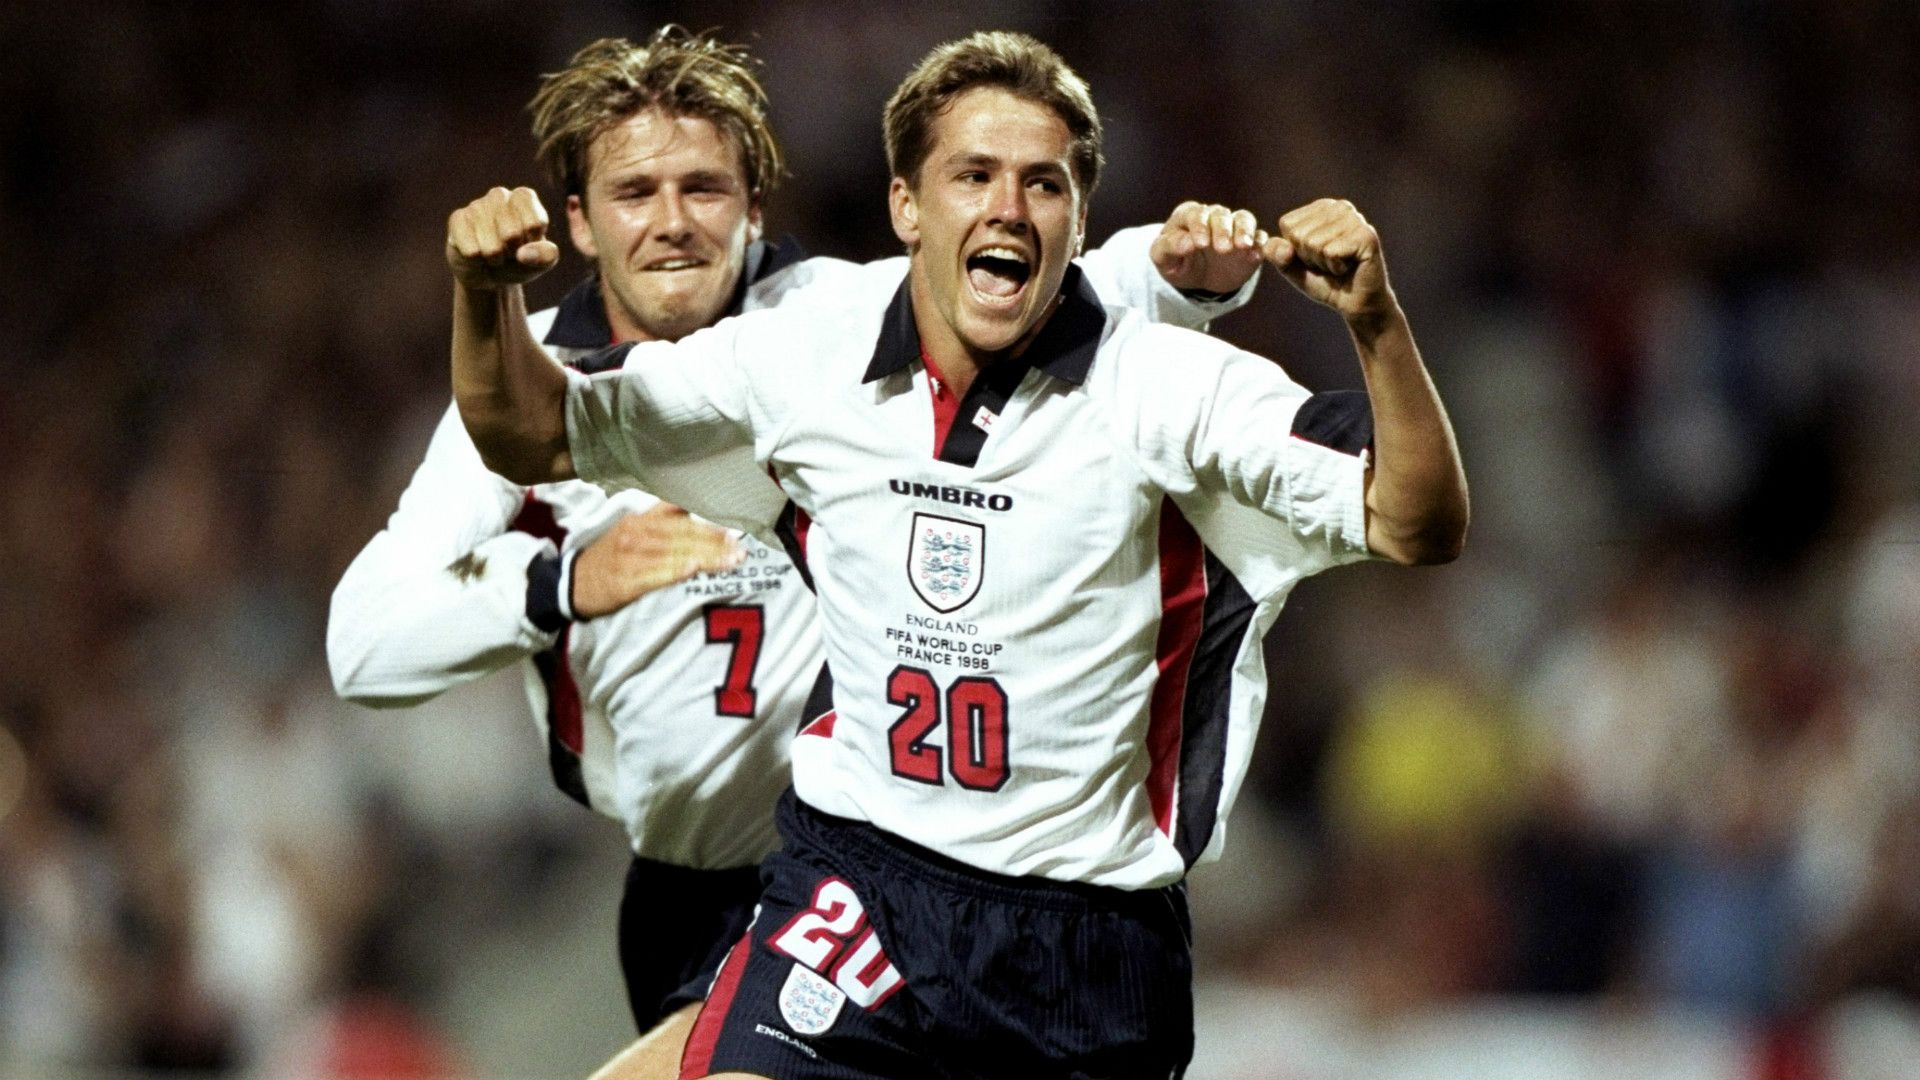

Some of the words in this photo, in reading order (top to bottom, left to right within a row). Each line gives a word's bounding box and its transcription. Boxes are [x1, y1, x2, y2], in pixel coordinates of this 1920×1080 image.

[889, 479, 1013, 512] UMBRO
[763, 564, 792, 576] CUP
[685, 582, 744, 595] FRANCE
[906, 613, 978, 636] ENGLAND
[886, 627, 913, 643] FIFA
[917, 634, 968, 653] WORLD
[972, 642, 1003, 656] CUP
[703, 603, 765, 719] 7
[898, 645, 951, 665] FRANCE
[957, 656, 989, 670] 1998
[887, 663, 1011, 792] 20
[755, 1023, 818, 1058] ENGLAND
